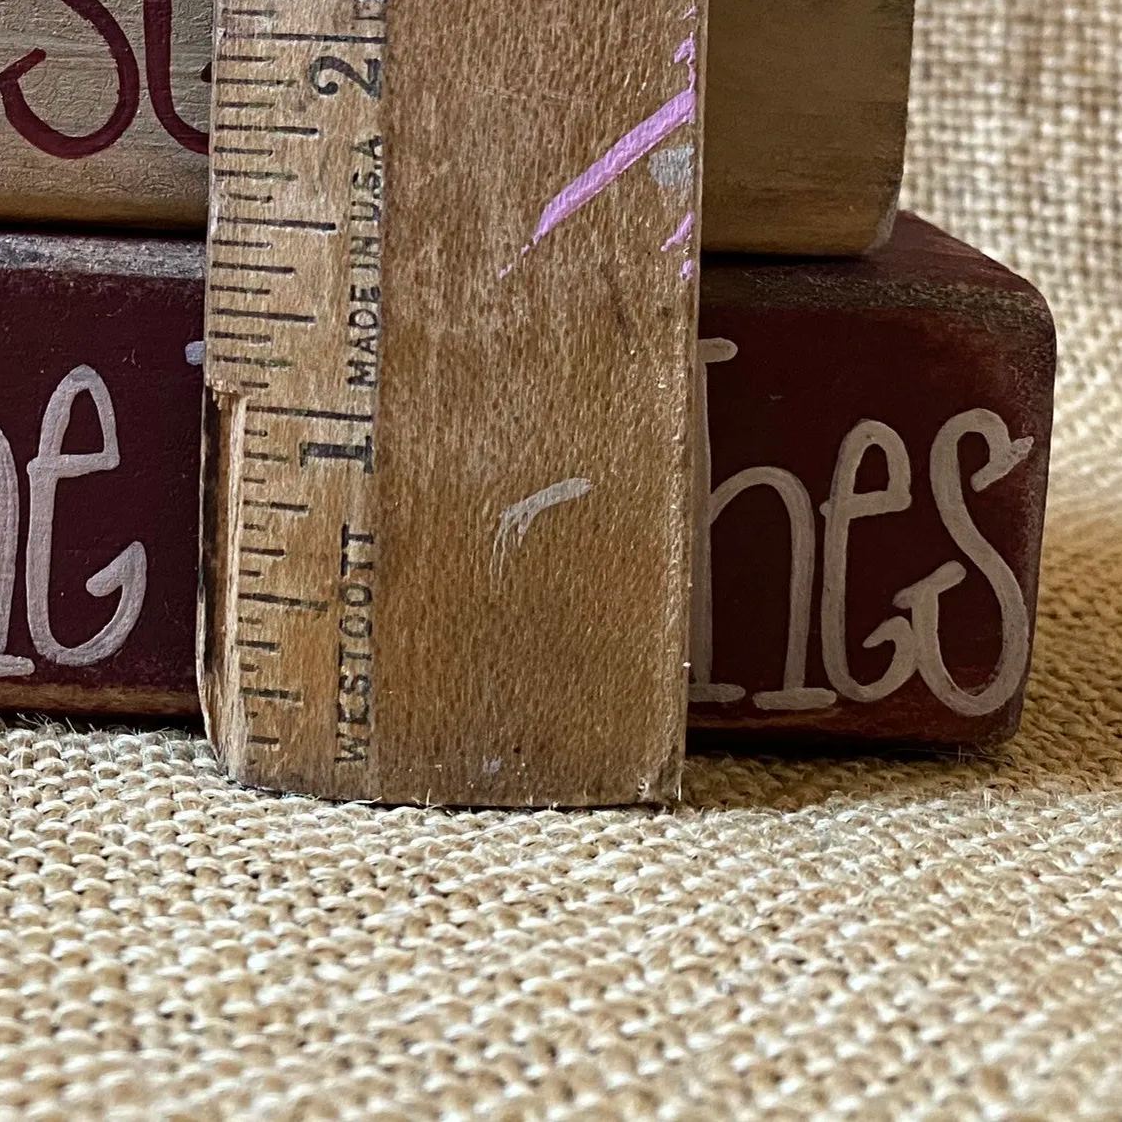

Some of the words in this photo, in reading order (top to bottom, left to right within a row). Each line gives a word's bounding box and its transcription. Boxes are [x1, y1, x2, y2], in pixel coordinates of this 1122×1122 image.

[307, 55, 382, 100] 2
[348, 236, 381, 270] IN
[346, 284, 382, 387] MADE
[299, 435, 374, 475] 1
[334, 522, 374, 765] WESTCOTT
